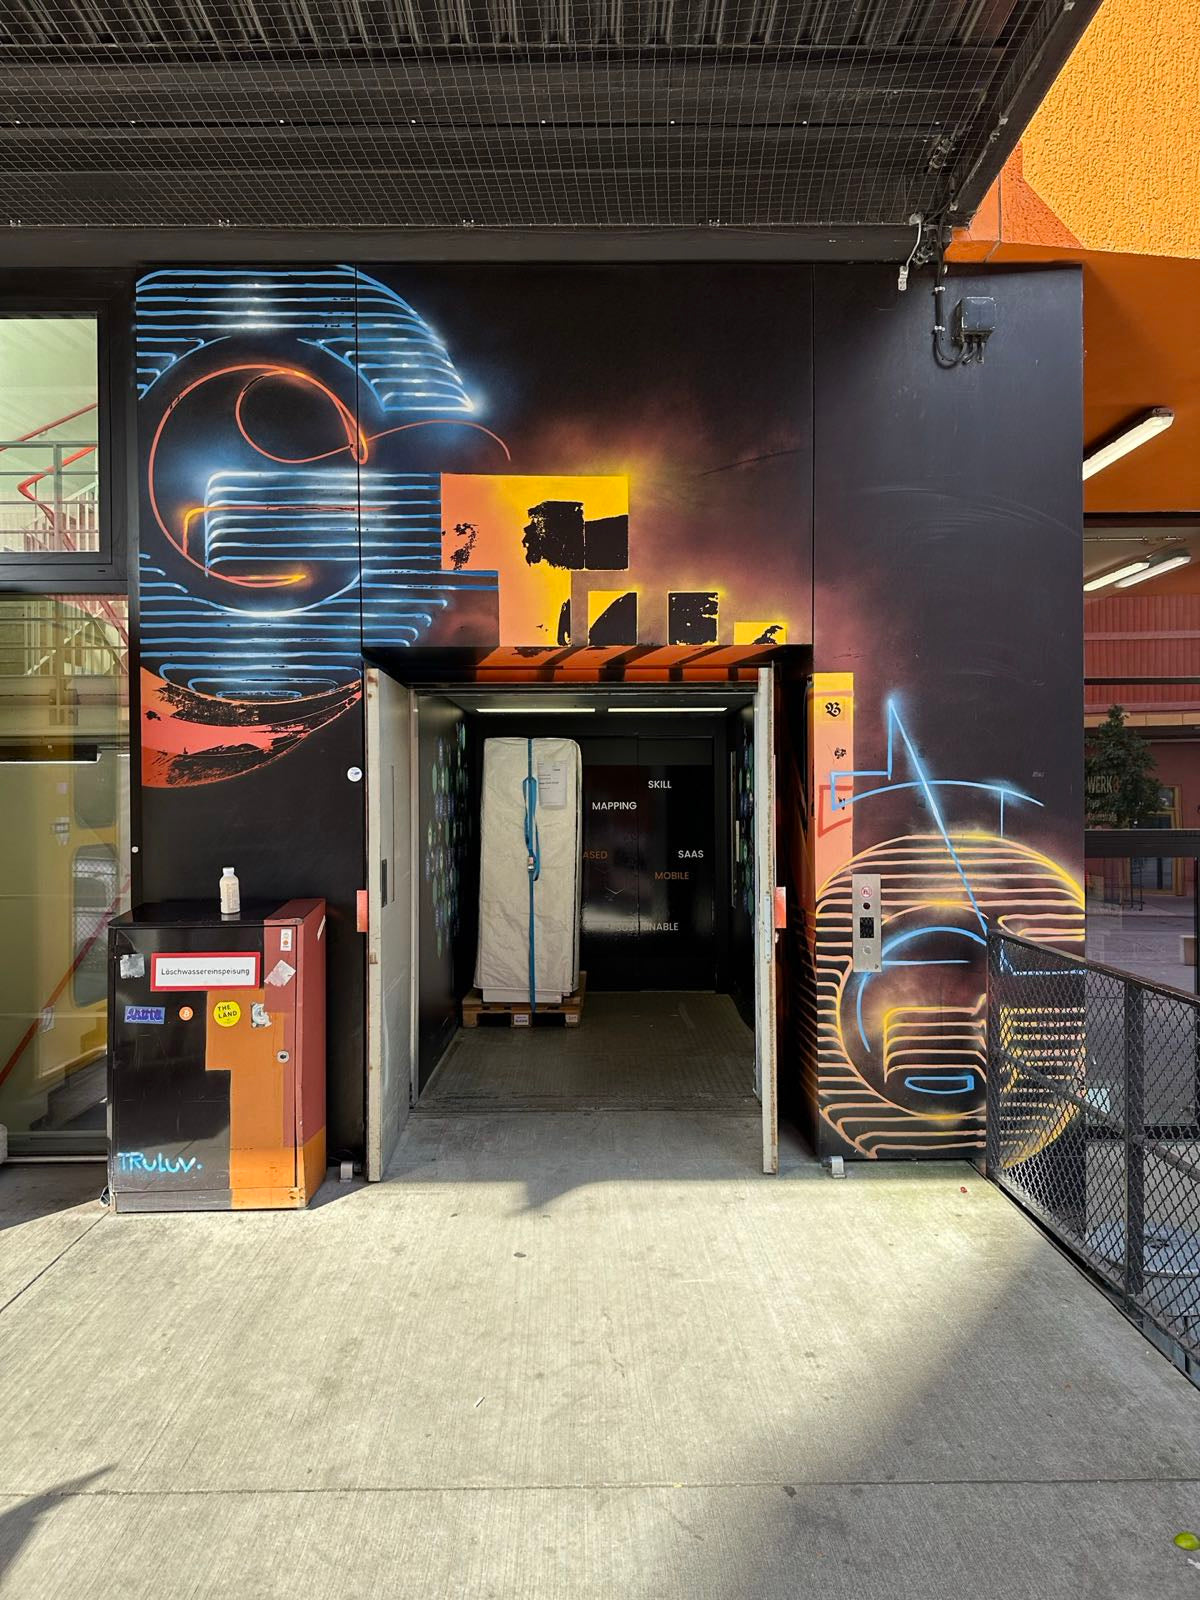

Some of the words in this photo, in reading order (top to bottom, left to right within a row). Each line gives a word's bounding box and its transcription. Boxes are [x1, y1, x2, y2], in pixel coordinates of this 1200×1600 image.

[647, 780, 672, 789] SKILL
[591, 801, 638, 811] MAPPING
[677, 849, 704, 859] SAAS
[654, 871, 690, 881] MOBILE
[161, 967, 250, 977] Löschwassereinspeisung
[217, 1004, 231, 1013] THE
[218, 1010, 238, 1019] LAND
